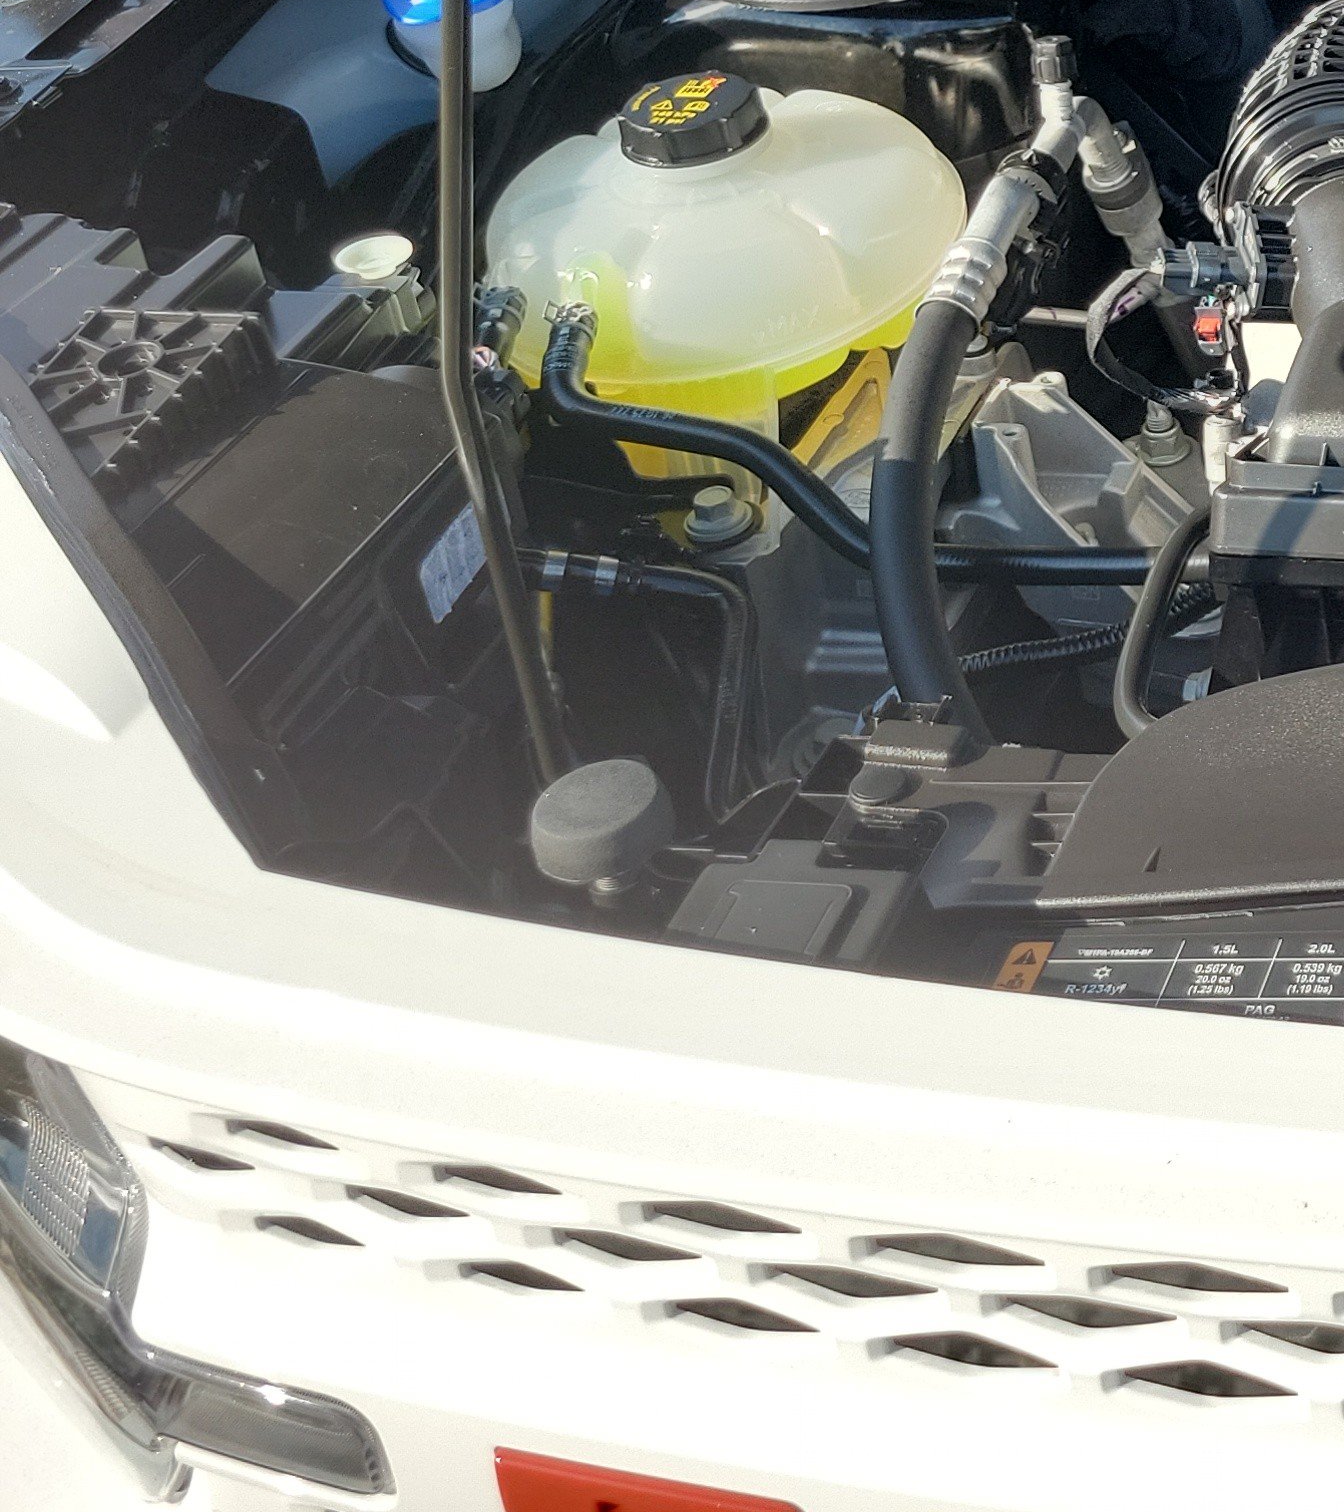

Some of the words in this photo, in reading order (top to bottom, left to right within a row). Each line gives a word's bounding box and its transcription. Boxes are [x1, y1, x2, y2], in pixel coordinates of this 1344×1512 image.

[1212, 944, 1238, 955] 1.5L
[1307, 944, 1335, 954] 2.0L
[1194, 963, 1227, 974] 0.567
[1228, 963, 1244, 976] kg
[1292, 963, 1325, 973] 0.539
[1326, 963, 1343, 975] kg
[1195, 975, 1217, 983] 20.0
[1295, 975, 1316, 983] 19.0
[1064, 983, 1128, 996] R-1234yf
[1187, 985, 1213, 995] (1.25
[1213, 985, 1234, 995] lbs)
[1286, 984, 1312, 995] (1.19
[1312, 984, 1333, 995] lbs)
[1244, 1004, 1276, 1015] PAG
